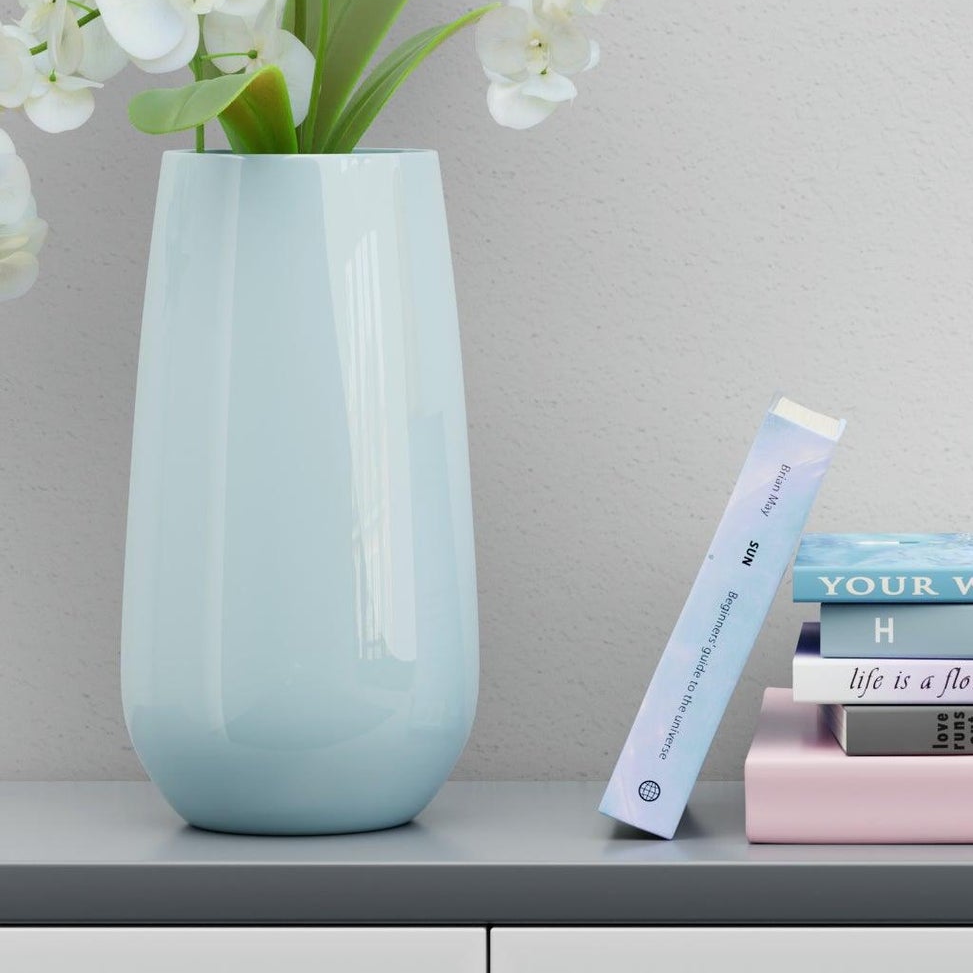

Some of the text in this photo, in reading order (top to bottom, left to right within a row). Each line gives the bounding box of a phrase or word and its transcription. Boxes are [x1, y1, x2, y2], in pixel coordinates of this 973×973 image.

[760, 463, 791, 517] Brian May
[741, 540, 759, 567] SUN
[819, 576, 942, 596] YOUR
[693, 646, 712, 679] guide
[687, 678, 698, 692] to
[849, 667, 883, 697] life
[894, 670, 911, 690] is
[920, 675, 935, 690] a
[678, 694, 691, 714] the
[658, 715, 682, 761] universe
[932, 713, 949, 749] love
[953, 711, 966, 750] runs
